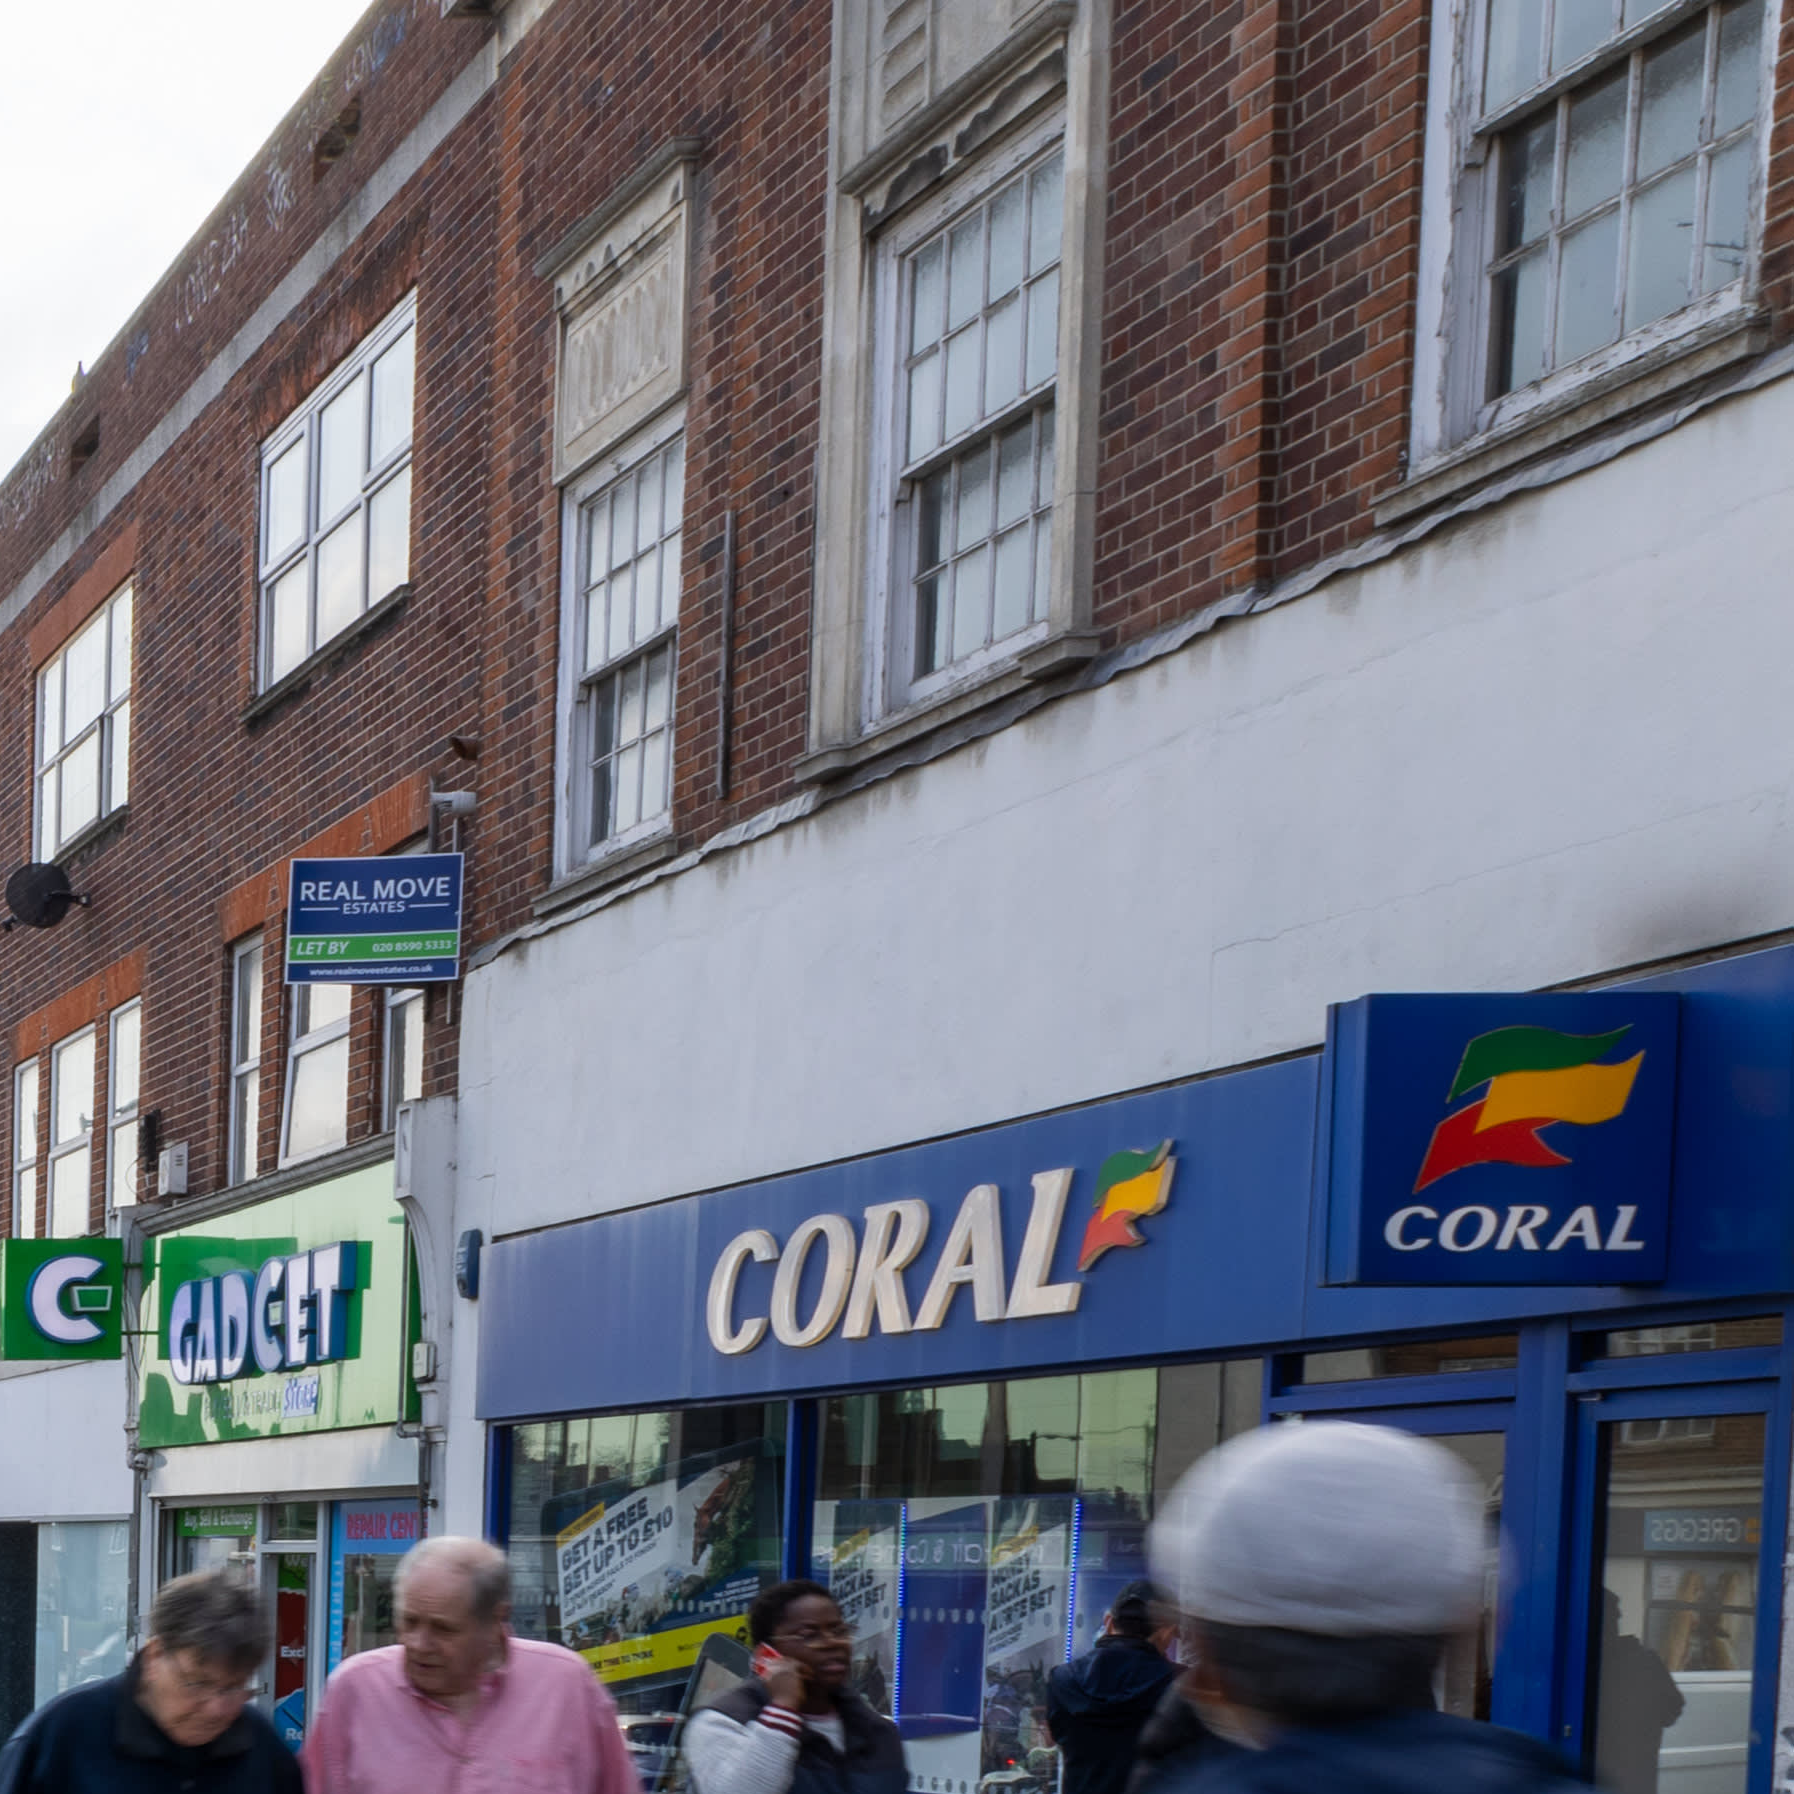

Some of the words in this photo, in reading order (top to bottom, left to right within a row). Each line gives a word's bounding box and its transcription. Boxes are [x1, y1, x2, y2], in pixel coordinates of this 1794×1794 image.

[299, 880, 367, 902] REAL
[372, 876, 451, 900] MOVE
[342, 901, 406, 915] ESTATES
[296, 941, 326, 956] LET
[327, 940, 350, 955] BY
[371, 942, 392, 953] 020
[1382, 1203, 1647, 1254] CORAL
[706, 1167, 1083, 1356] CORAL
[199, 1512, 212, 1527] Sell
[220, 1510, 254, 1530] Exchange
[347, 1512, 389, 1539] REPAIR
[562, 1535, 589, 1573] GET
[592, 1527, 604, 1551] A
[605, 1496, 649, 1540] FREE
[562, 1558, 591, 1596] BET
[592, 1544, 615, 1575] UP
[617, 1527, 641, 1557] TO
[641, 1505, 673, 1543] £10
